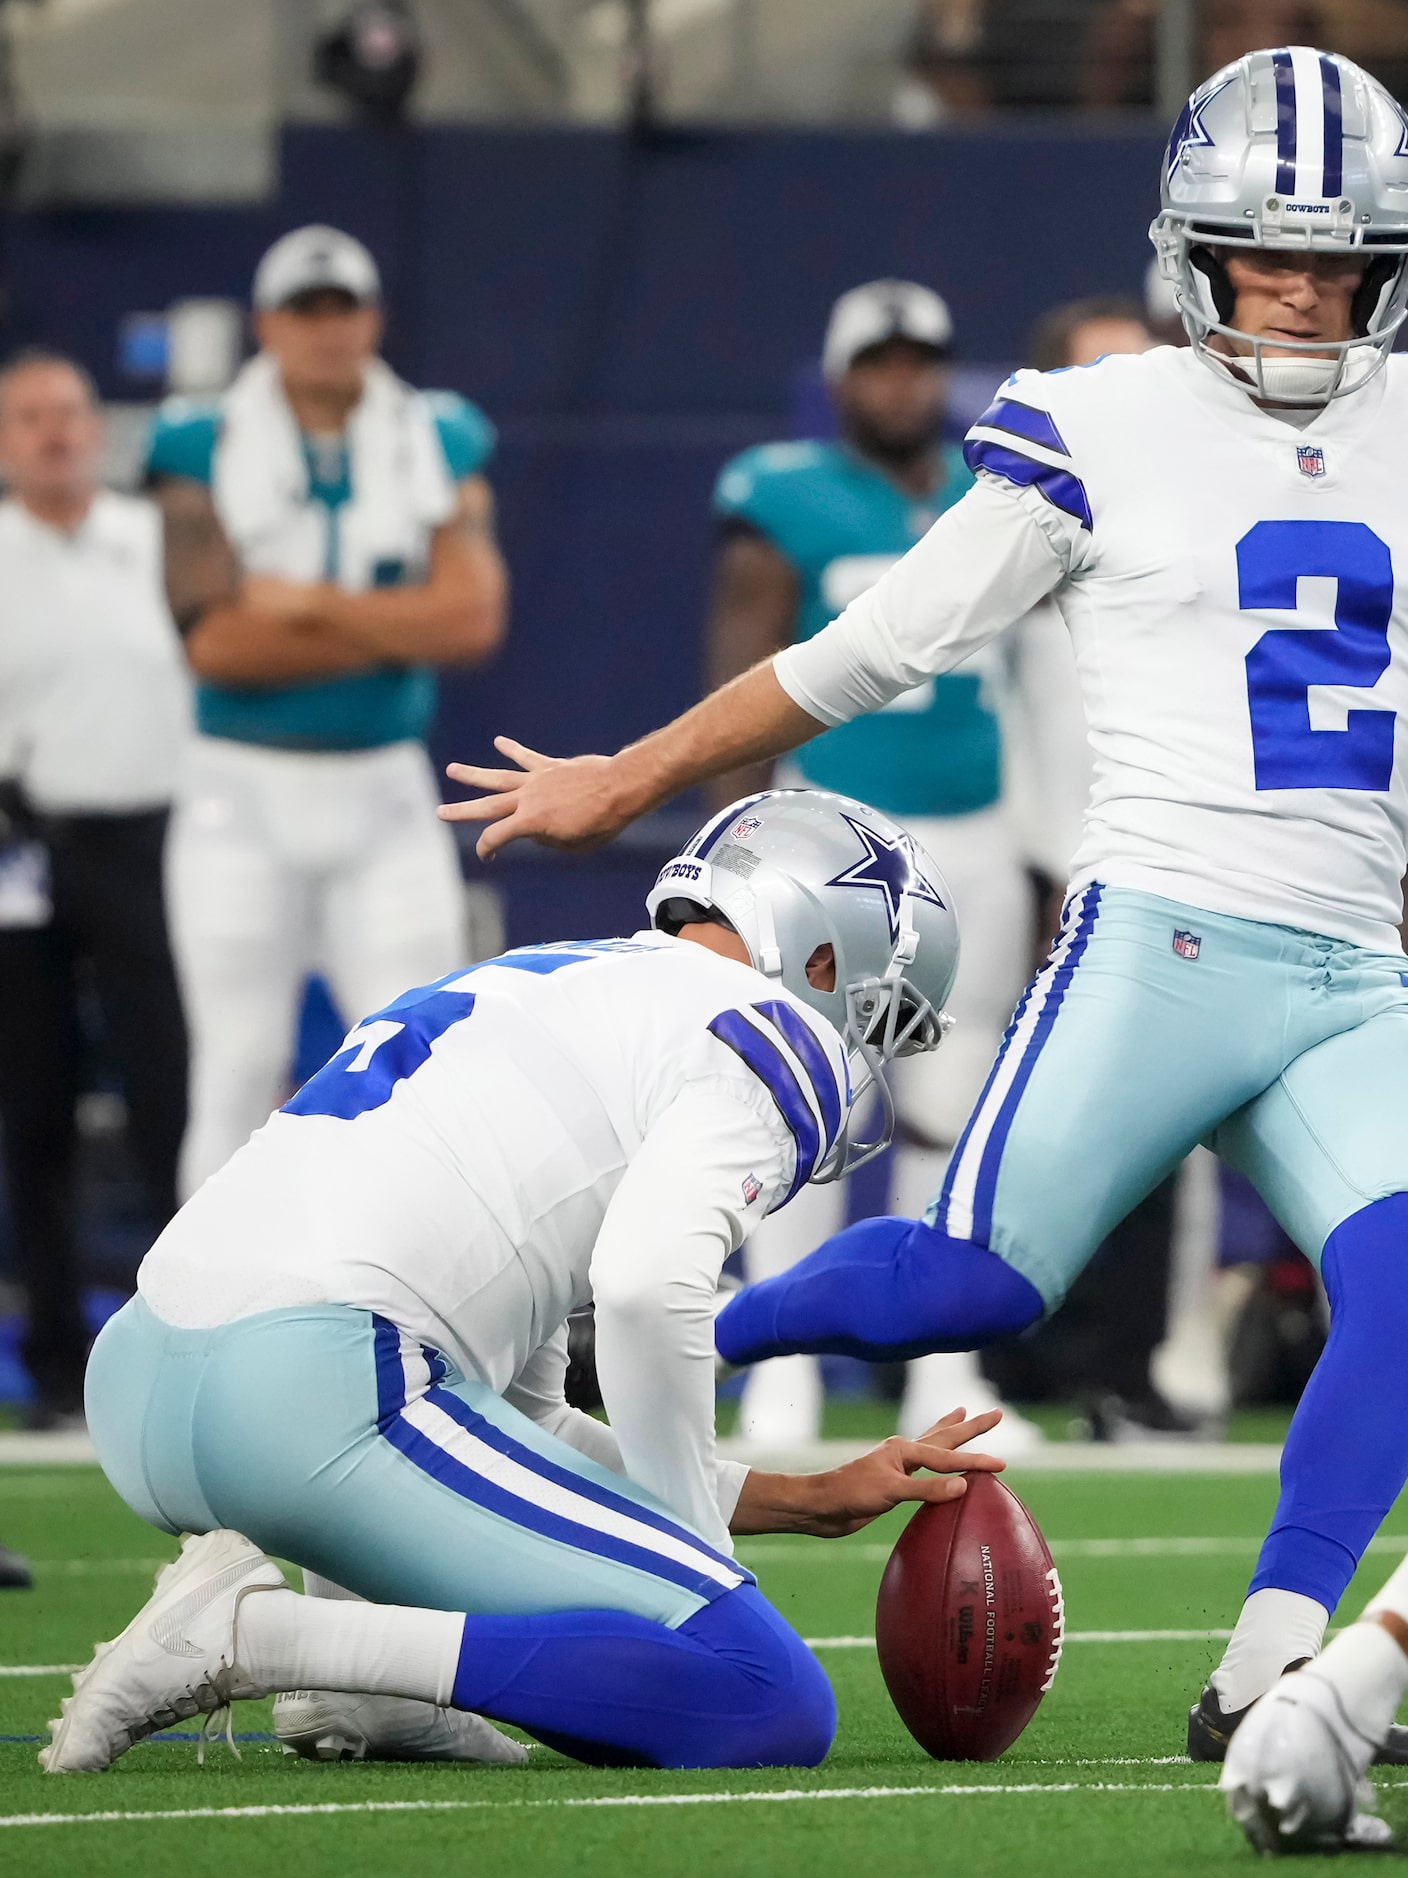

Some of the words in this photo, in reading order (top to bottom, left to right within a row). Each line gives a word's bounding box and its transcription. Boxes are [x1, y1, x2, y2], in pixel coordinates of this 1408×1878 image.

[1286, 203, 1330, 213] COWBOYS
[1235, 520, 1397, 791] 2
[980, 1545, 996, 1606] NATIONAL
[984, 1611, 996, 1674] FOOTBALL
